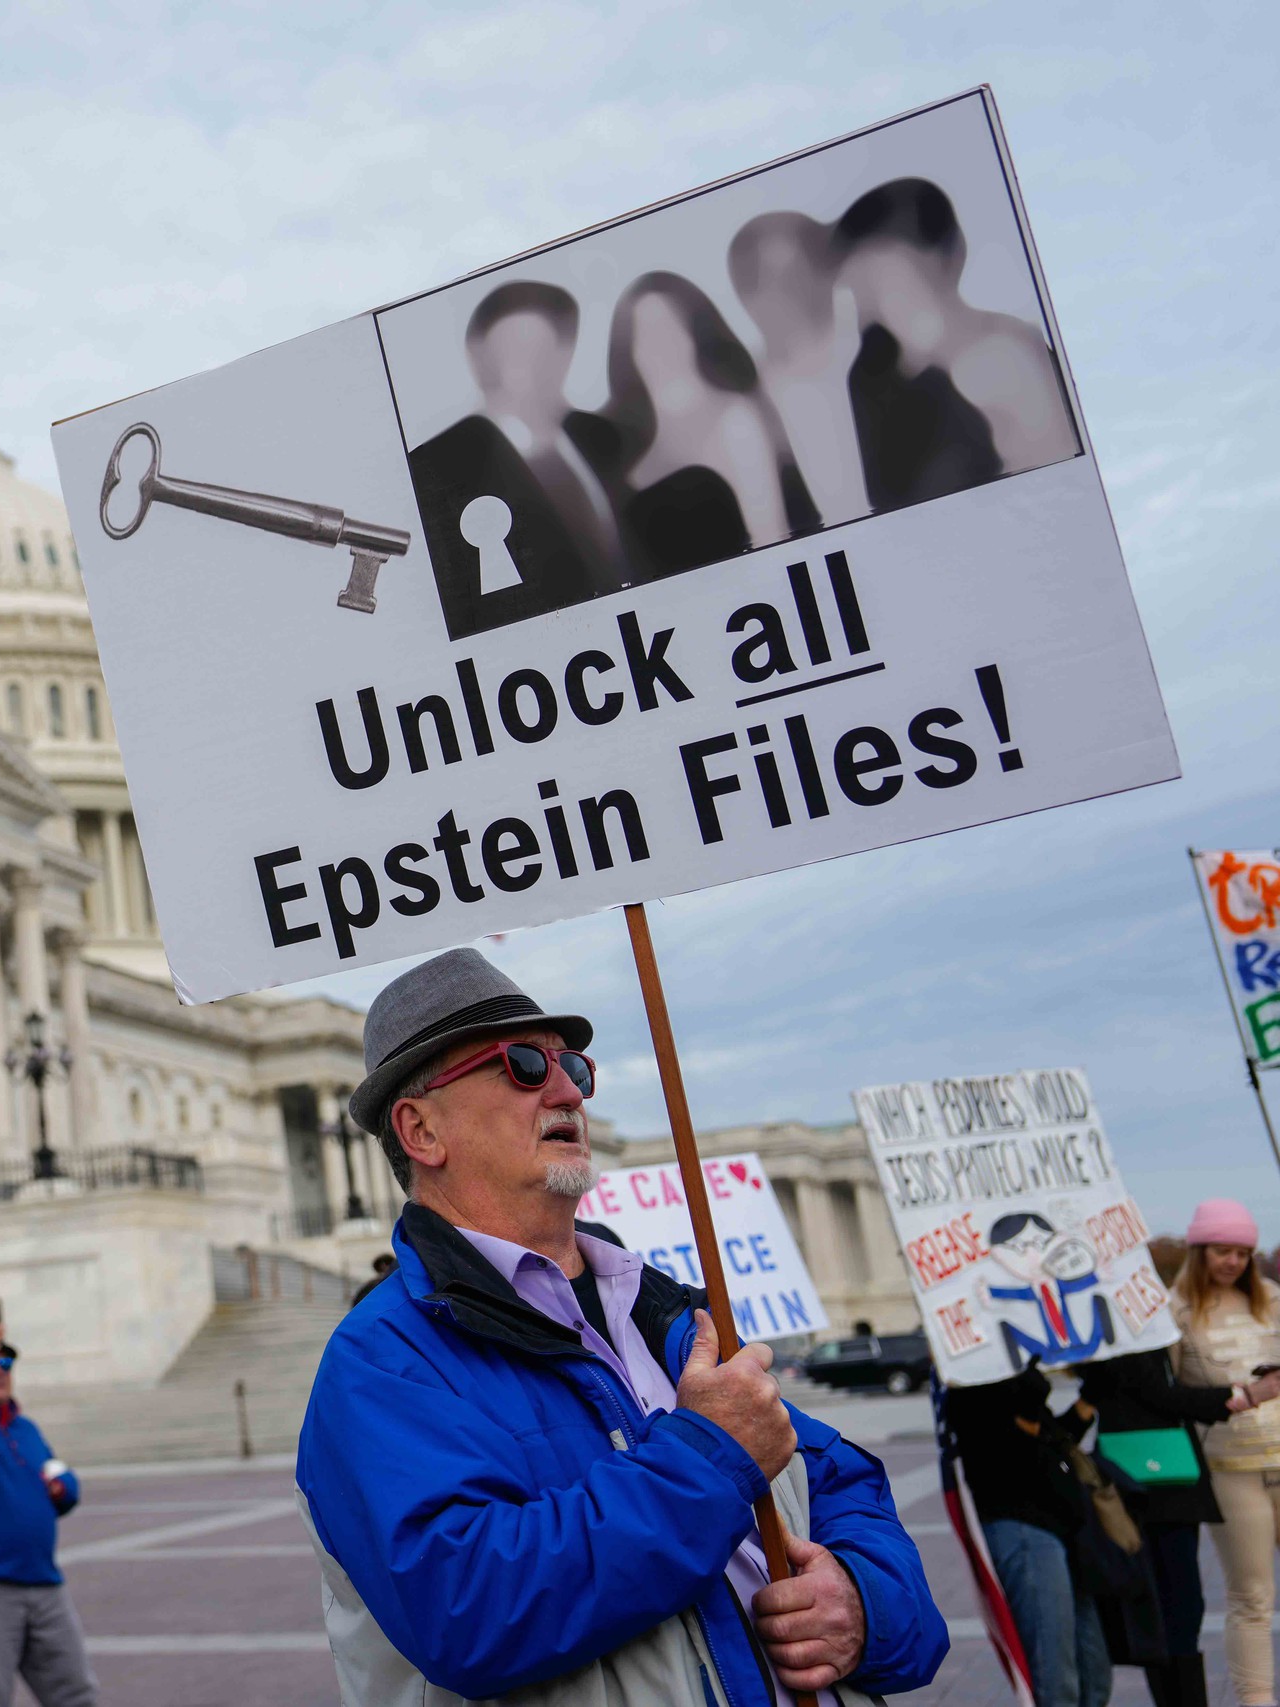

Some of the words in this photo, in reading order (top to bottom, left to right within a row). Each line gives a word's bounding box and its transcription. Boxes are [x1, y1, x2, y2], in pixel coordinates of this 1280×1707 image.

[316, 611, 695, 791] Unlock
[726, 550, 871, 684] all
[254, 780, 651, 960] Epstein
[679, 664, 1024, 846] Files!
[629, 1162, 733, 1209] CAE
[907, 1212, 990, 1287] RELEASE
[936, 1299, 983, 1351] THE
[1114, 1265, 1166, 1332] FILES
